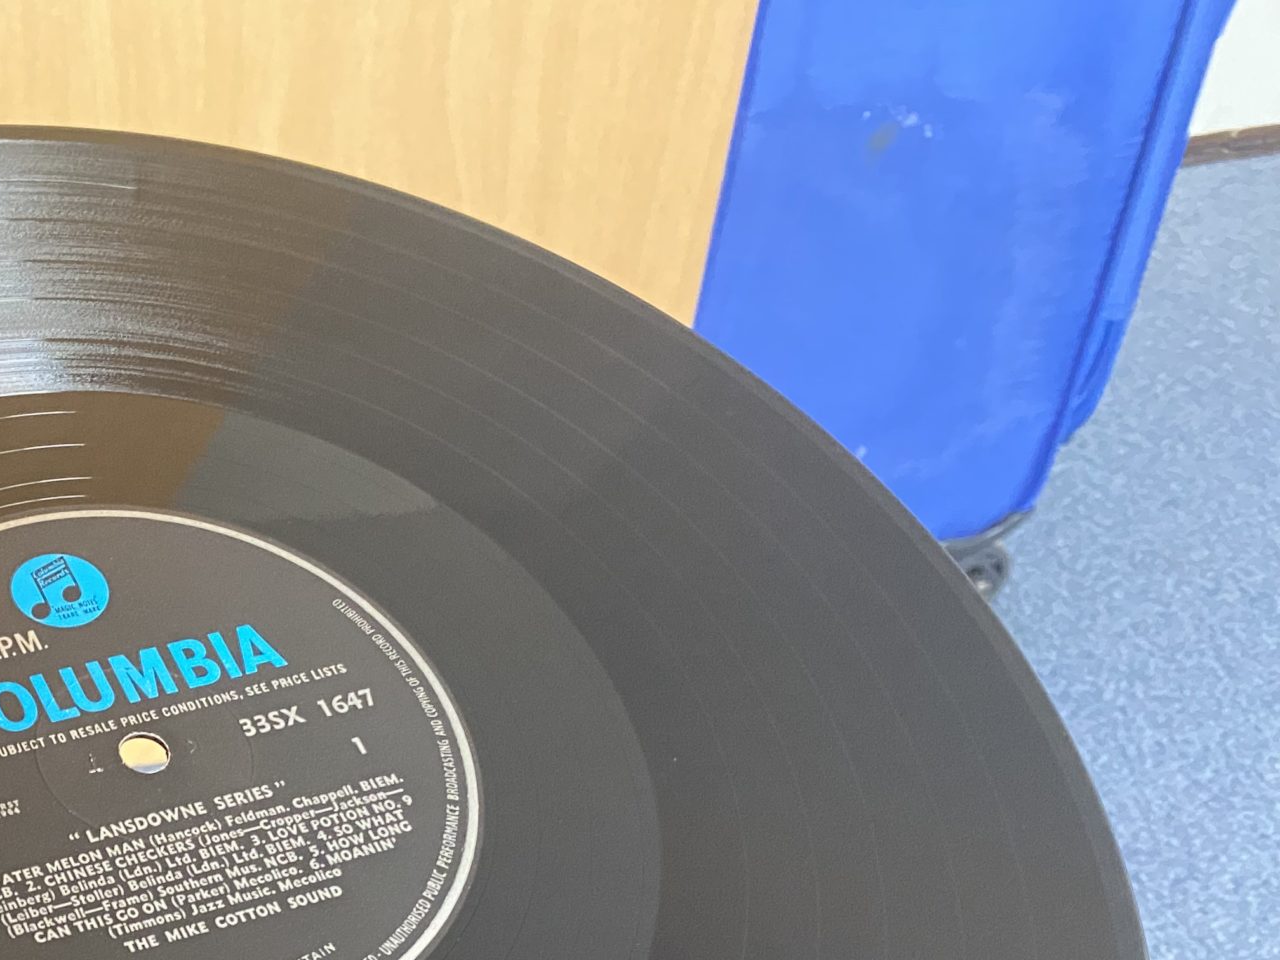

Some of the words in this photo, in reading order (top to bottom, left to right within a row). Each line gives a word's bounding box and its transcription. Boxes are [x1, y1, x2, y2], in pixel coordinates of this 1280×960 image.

[332, 598, 376, 635] PROHIBITED
[372, 634, 400, 661] RECORD
[394, 659, 412, 678] THIS
[49, 733, 67, 746] TO
[70, 719, 118, 740] RESALE
[120, 709, 159, 727] PRICE
[163, 690, 244, 717] CONDITIONS,
[245, 682, 270, 697] SEE
[272, 672, 310, 691] PRICE
[310, 663, 348, 681] LISTS
[405, 676, 420, 687] OF
[413, 686, 439, 718] COPYING
[239, 705, 307, 737] 33SX
[317, 687, 374, 717] 1647
[430, 719, 447, 737] AND
[351, 736, 367, 755] 1
[437, 739, 460, 801] BROADCASTING
[46, 849, 103, 874] MELON
[106, 838, 146, 860] MAN
[149, 819, 222, 848] (Hancock)
[224, 805, 291, 828] Feldman.
[291, 784, 359, 810] Chappell.
[359, 773, 404, 791] BIEM.
[60, 874, 116, 896] Belinda
[119, 861, 162, 883] (Ldn.)
[165, 852, 197, 869] Ltd.
[200, 840, 244, 860] BIEM.
[250, 834, 266, 847] 3.
[267, 821, 309, 842] LOVE
[311, 807, 370, 831] POTION
[372, 799, 401, 817] NO.
[401, 794, 413, 807] 9
[128, 869, 183, 892] Belinda
[186, 857, 229, 878] (Ldn.)
[232, 847, 264, 864] Ltd.
[265, 836, 311, 855] BIEM.
[316, 829, 332, 841] 4.
[334, 823, 354, 837] SO
[355, 809, 404, 831] WHAT
[436, 803, 460, 869] PERFORMANCE
[25, 880, 42, 893] 2.
[44, 861, 113, 887] CHINESE
[115, 838, 195, 868] CHECKERS
[157, 873, 223, 898] Southern
[226, 862, 261, 879] Mus.
[264, 851, 303, 869] NCB.
[309, 845, 325, 858] 5.
[326, 833, 365, 852] HOW
[369, 821, 412, 840] LONG
[422, 869, 449, 901] PUBLIC
[34, 926, 72, 943] CAN
[73, 913, 113, 933] THIS
[116, 906, 139, 921] GO
[142, 899, 168, 915] ON
[170, 884, 231, 912] (Parker)
[233, 866, 303, 890] Mecolico.
[309, 857, 325, 870] 6.
[108, 909, 187, 939] (Timmons)
[191, 899, 225, 917] Jazz
[227, 887, 276, 906] Music.
[277, 868, 343, 893] Mecolico
[123, 935, 159, 953] THE
[165, 920, 210, 943] MIKE
[214, 900, 282, 929] COTTON
[287, 885, 343, 910] SOUND
[378, 898, 431, 956] UNAUTHORISED
